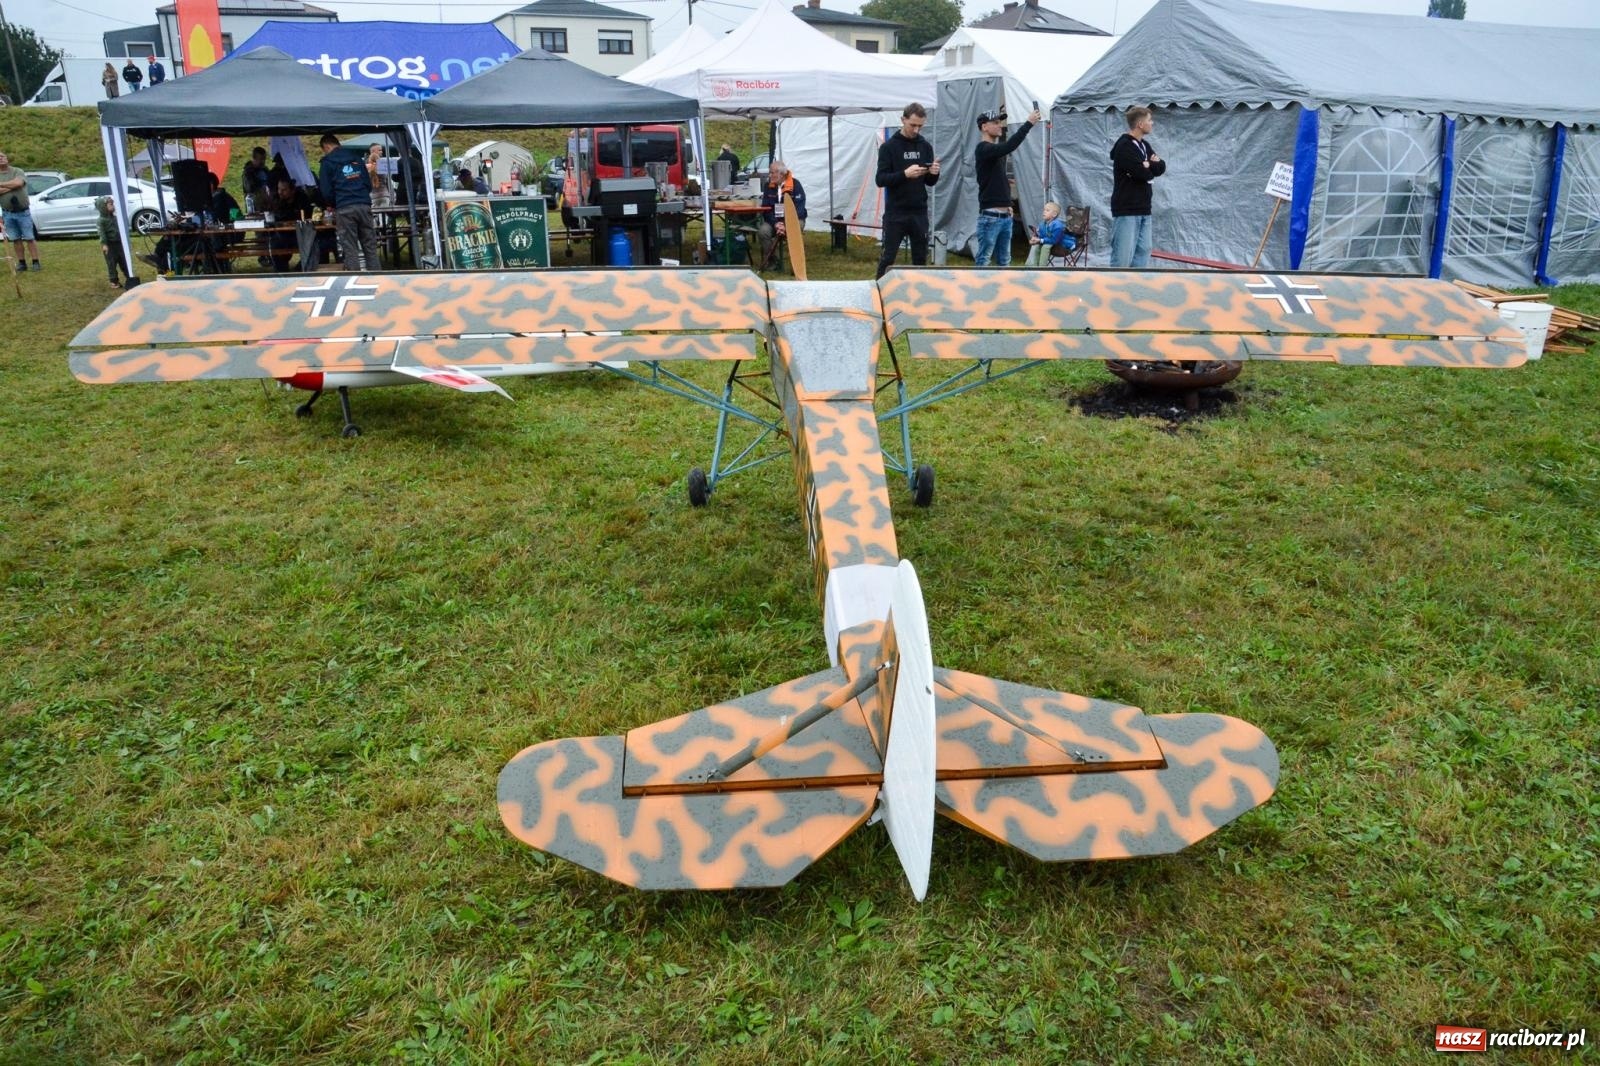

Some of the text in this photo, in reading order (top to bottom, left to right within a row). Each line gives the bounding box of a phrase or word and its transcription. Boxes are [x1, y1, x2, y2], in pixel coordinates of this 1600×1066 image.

[297, 53, 512, 88] trog.ne
[736, 80, 780, 89] Racibórz
[447, 229, 497, 252] BRACKIE
